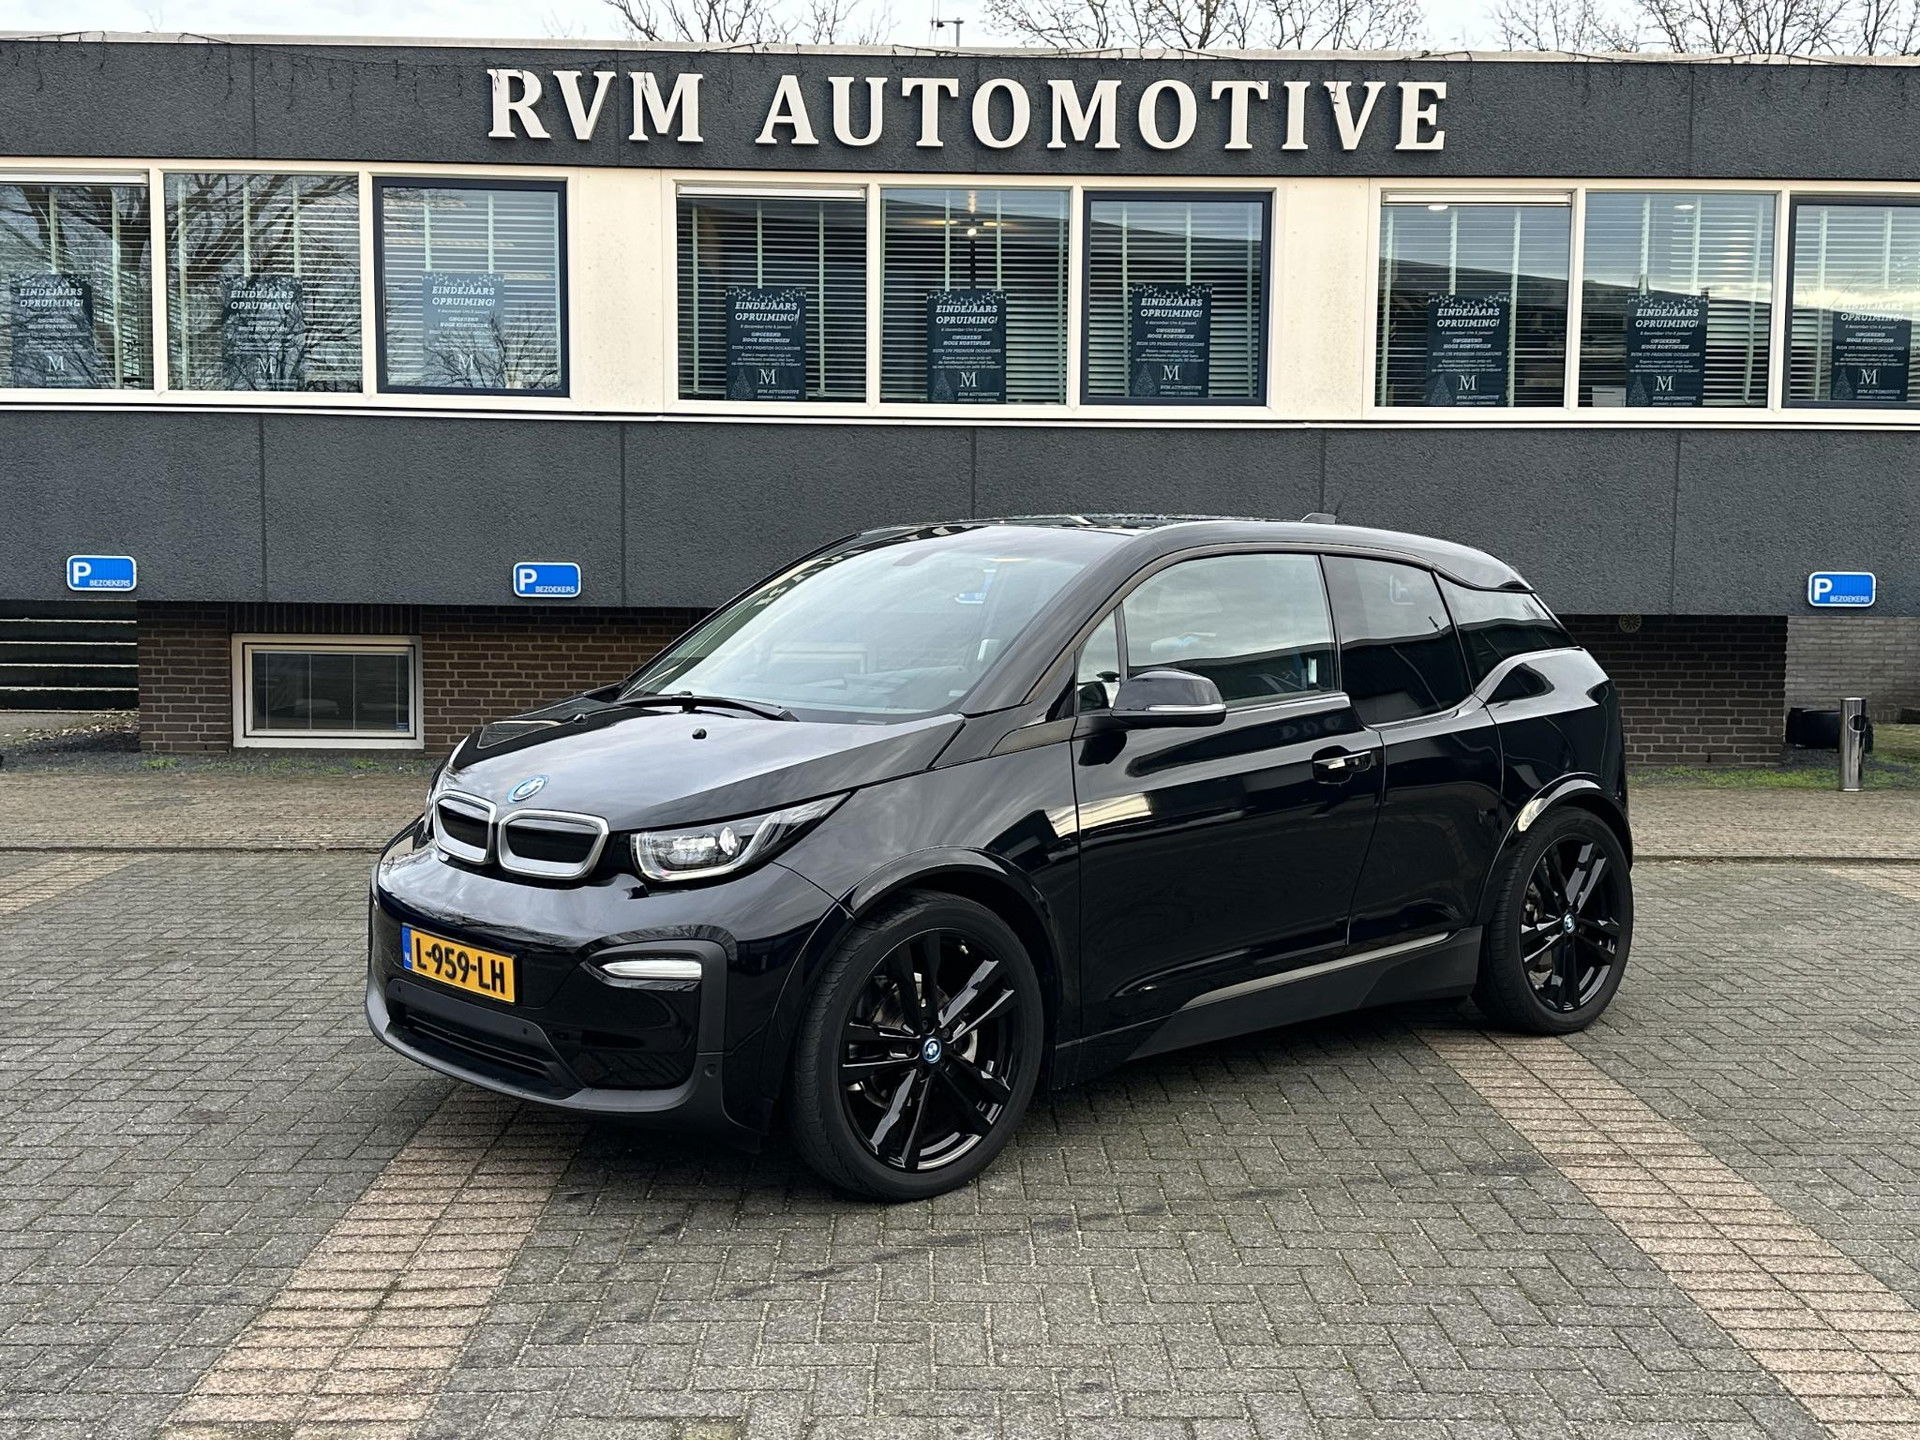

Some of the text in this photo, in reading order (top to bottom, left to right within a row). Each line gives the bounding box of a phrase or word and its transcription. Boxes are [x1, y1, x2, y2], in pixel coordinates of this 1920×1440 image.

[487, 69, 1448, 151] RVM AUTOMOTIVE
[20, 288, 82, 296] EINDEJAARS
[230, 291, 294, 299] EINDEJAARS
[432, 286, 495, 296] EINDEJAARS
[20, 300, 83, 308] OPRUIMING!
[432, 298, 496, 307] OPRUIMING!
[735, 302, 797, 311] EINDEJAARS
[1140, 298, 1203, 307] EINDEJAARS
[936, 305, 998, 313] EINDEJAARS
[1140, 309, 1203, 318] OPRUIMING!
[1437, 308, 1500, 317] EINDEJAARS
[1636, 309, 1699, 317] EINDEJAARS
[936, 316, 998, 324] OPRUIMING!
[1437, 319, 1500, 328] OPRUIMING!
[1635, 320, 1699, 328] OPRUIMING!
[73, 562, 91, 584] P
[519, 568, 537, 591] P
[1814, 578, 1833, 601] P
[416, 937, 506, 995] L-959-LH
